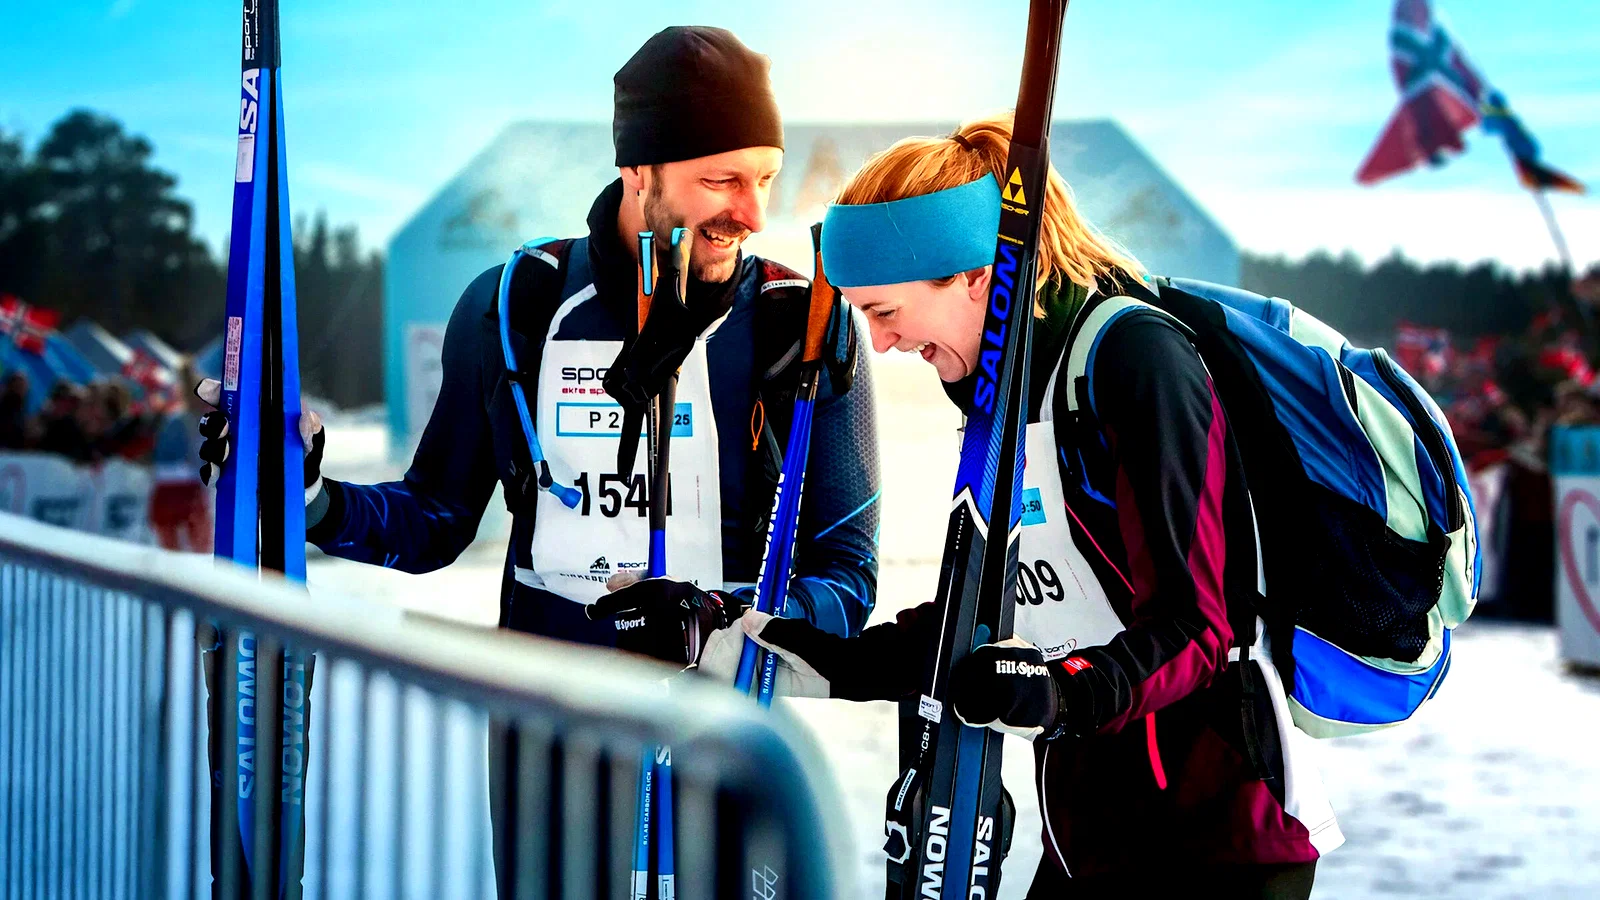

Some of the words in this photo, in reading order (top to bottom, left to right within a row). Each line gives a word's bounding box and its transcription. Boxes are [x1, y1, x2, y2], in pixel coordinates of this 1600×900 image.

[240, 68, 259, 133] SA
[562, 367, 611, 385] spo
[589, 388, 606, 396] sp
[590, 411, 601, 428] P
[238, 630, 256, 799] SALOMO
